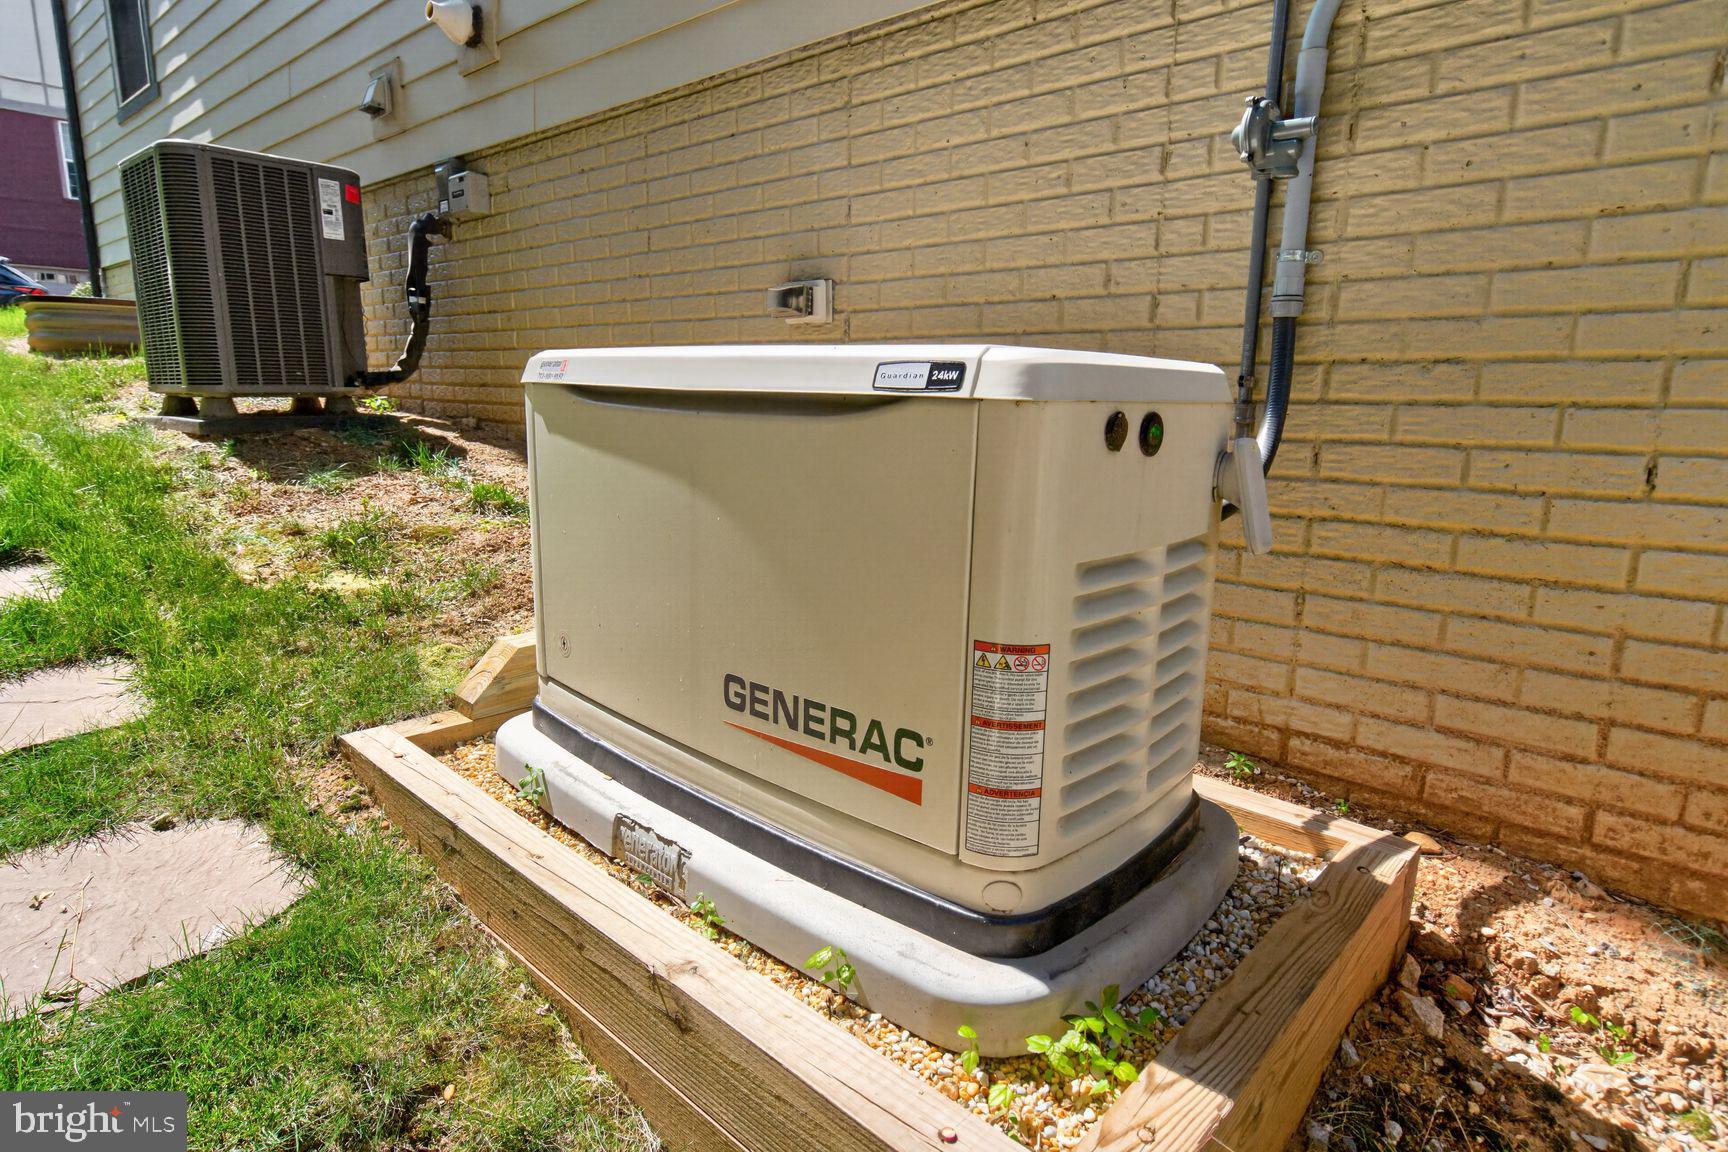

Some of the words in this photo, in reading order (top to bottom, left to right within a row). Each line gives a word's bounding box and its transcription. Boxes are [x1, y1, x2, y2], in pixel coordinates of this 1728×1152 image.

[880, 372, 924, 380] Guardian
[931, 370, 960, 380] 24kW
[999, 646, 1036, 654] WARNING
[982, 720, 1042, 729] AVERTISSEMENT
[984, 788, 1036, 798] ADVERTENCIA
